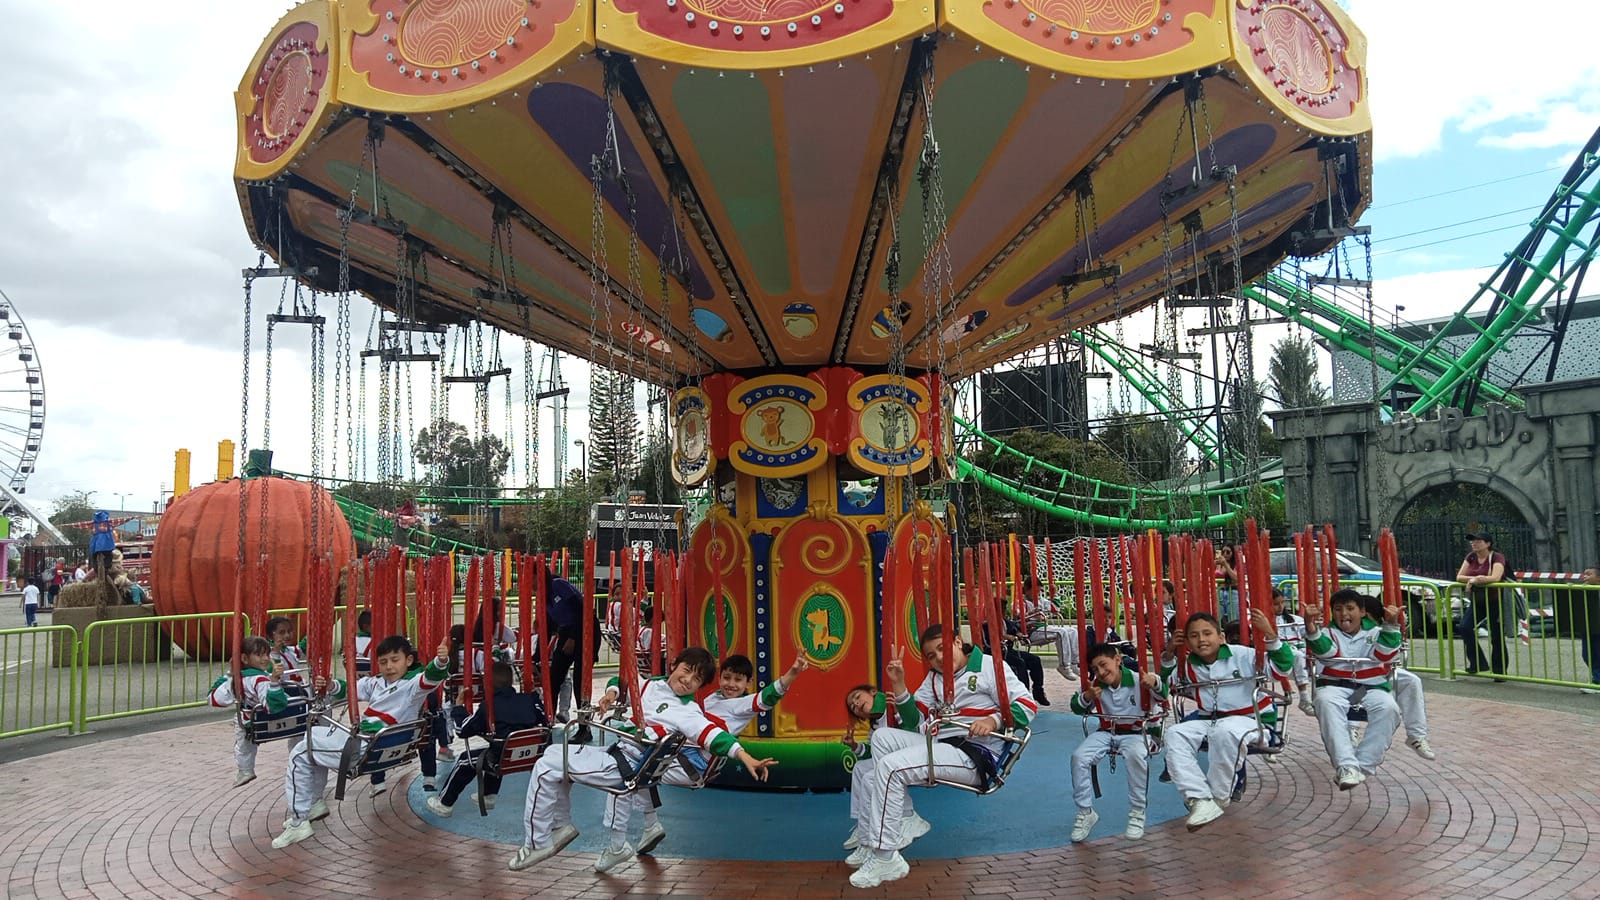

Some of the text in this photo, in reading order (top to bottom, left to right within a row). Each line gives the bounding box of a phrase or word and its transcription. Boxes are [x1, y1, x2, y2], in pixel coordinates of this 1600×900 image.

[629, 511, 647, 520] Juan
[275, 721, 287, 729] 31
[518, 749, 532, 759] 30
